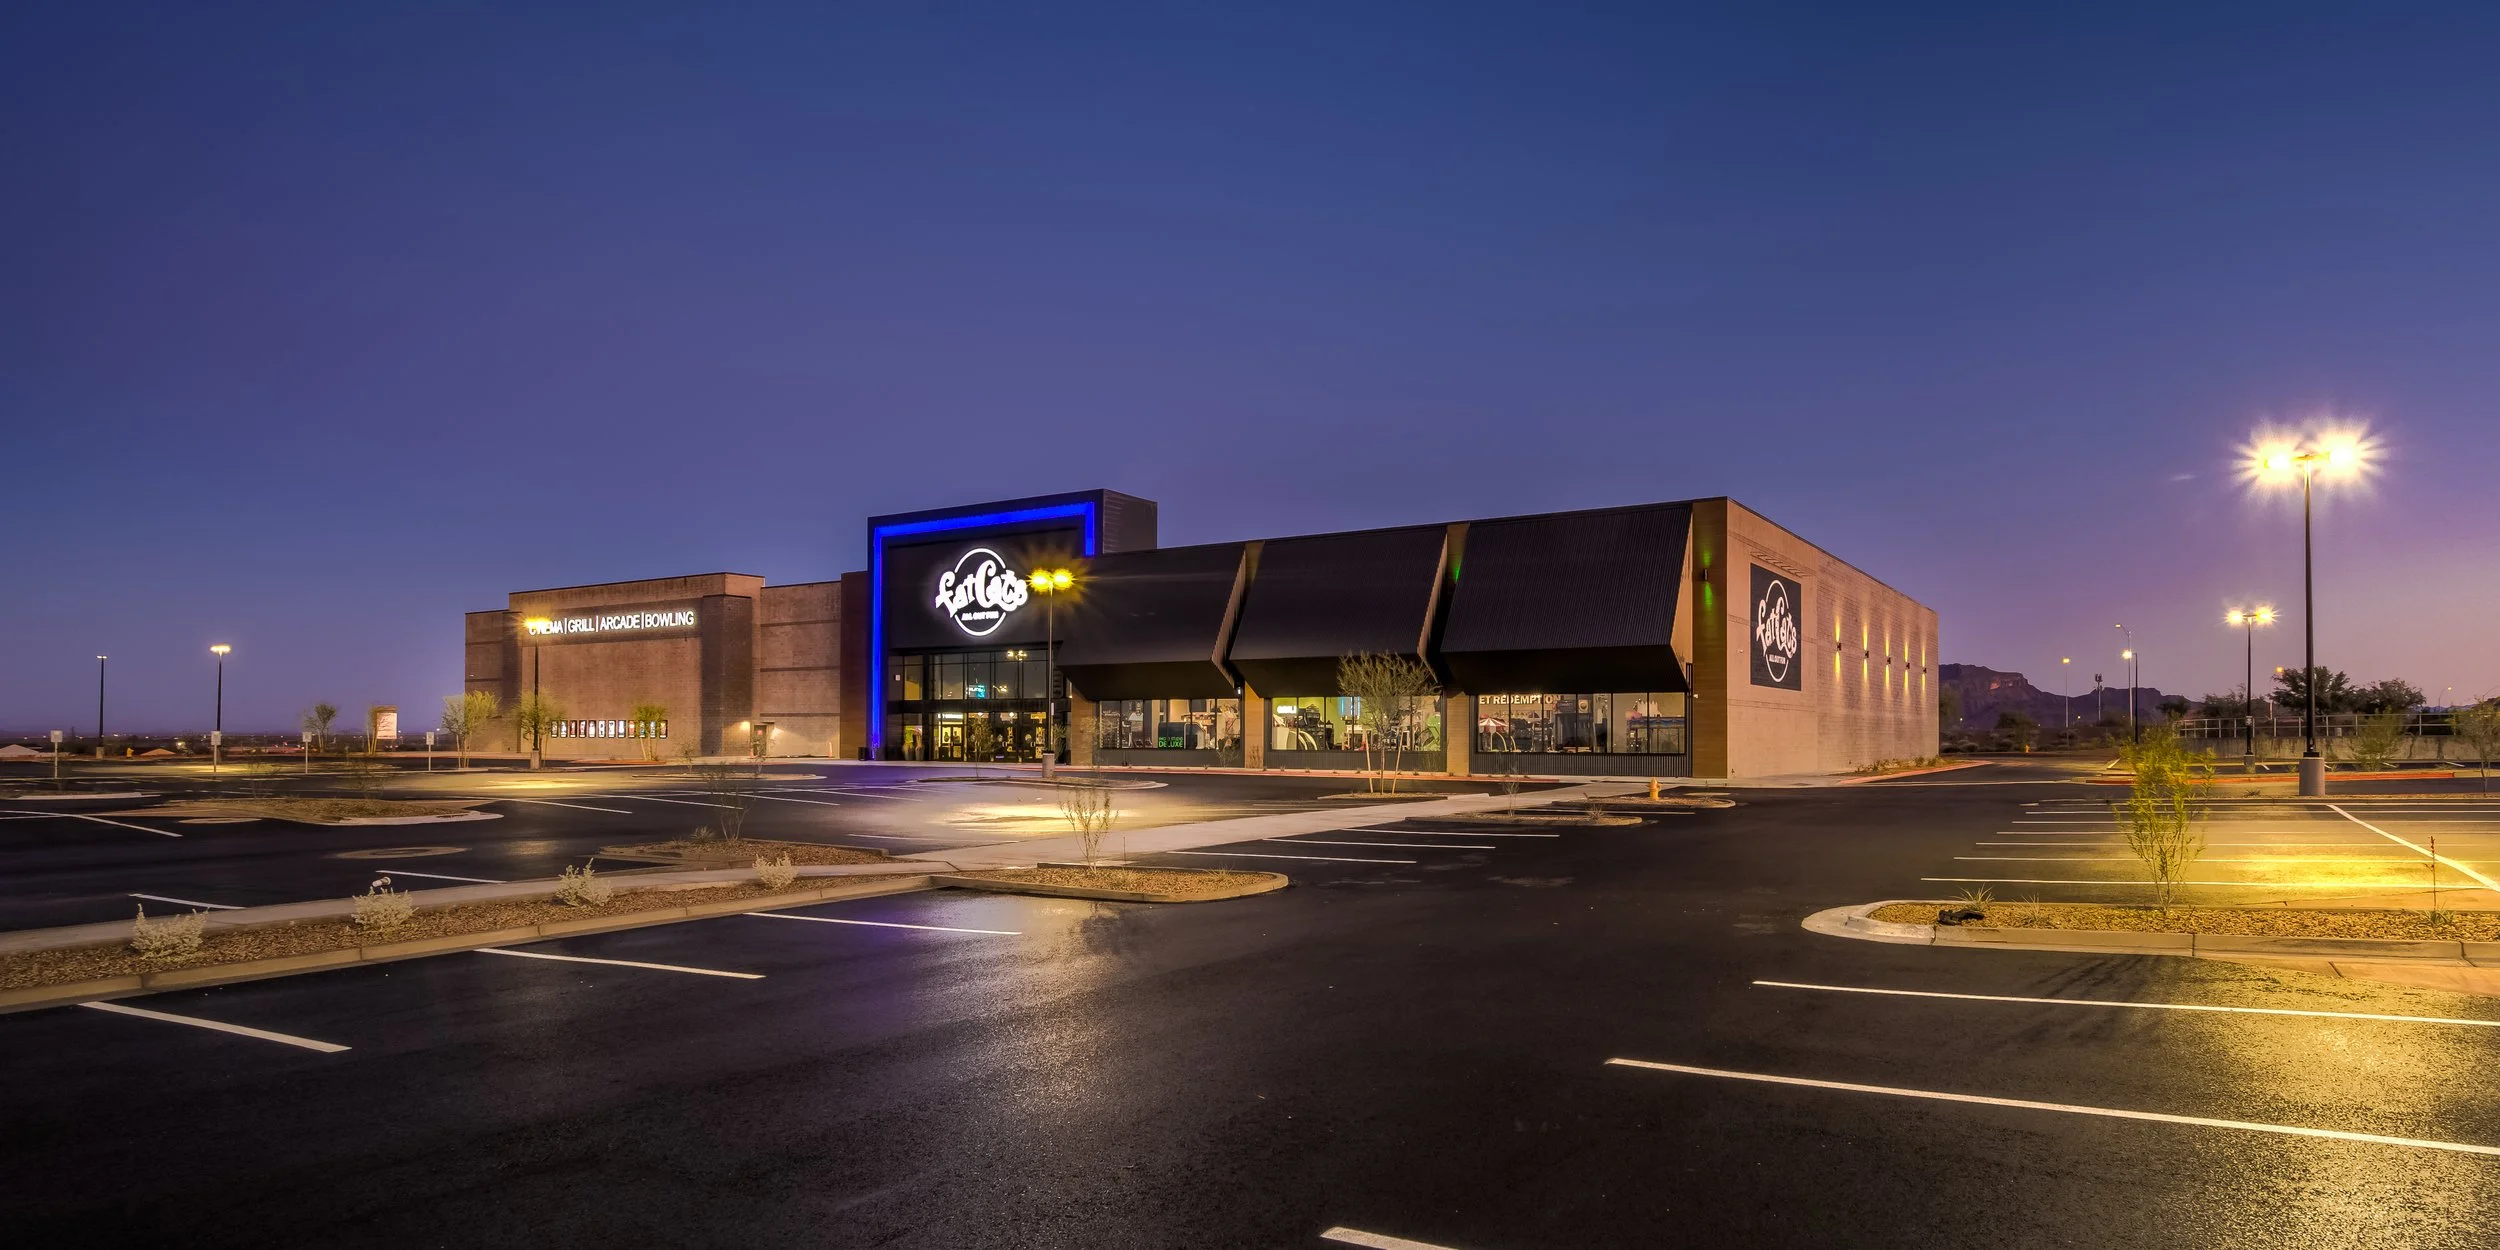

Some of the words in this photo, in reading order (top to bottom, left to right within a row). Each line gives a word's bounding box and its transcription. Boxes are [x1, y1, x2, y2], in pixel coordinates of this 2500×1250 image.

[529, 621, 563, 635] CNEMA
[568, 618, 594, 632] GRILL
[600, 614, 640, 631] ARCADE
[645, 611, 694, 628] BOWLING
[1493, 694, 1561, 705] REDEMPTON
